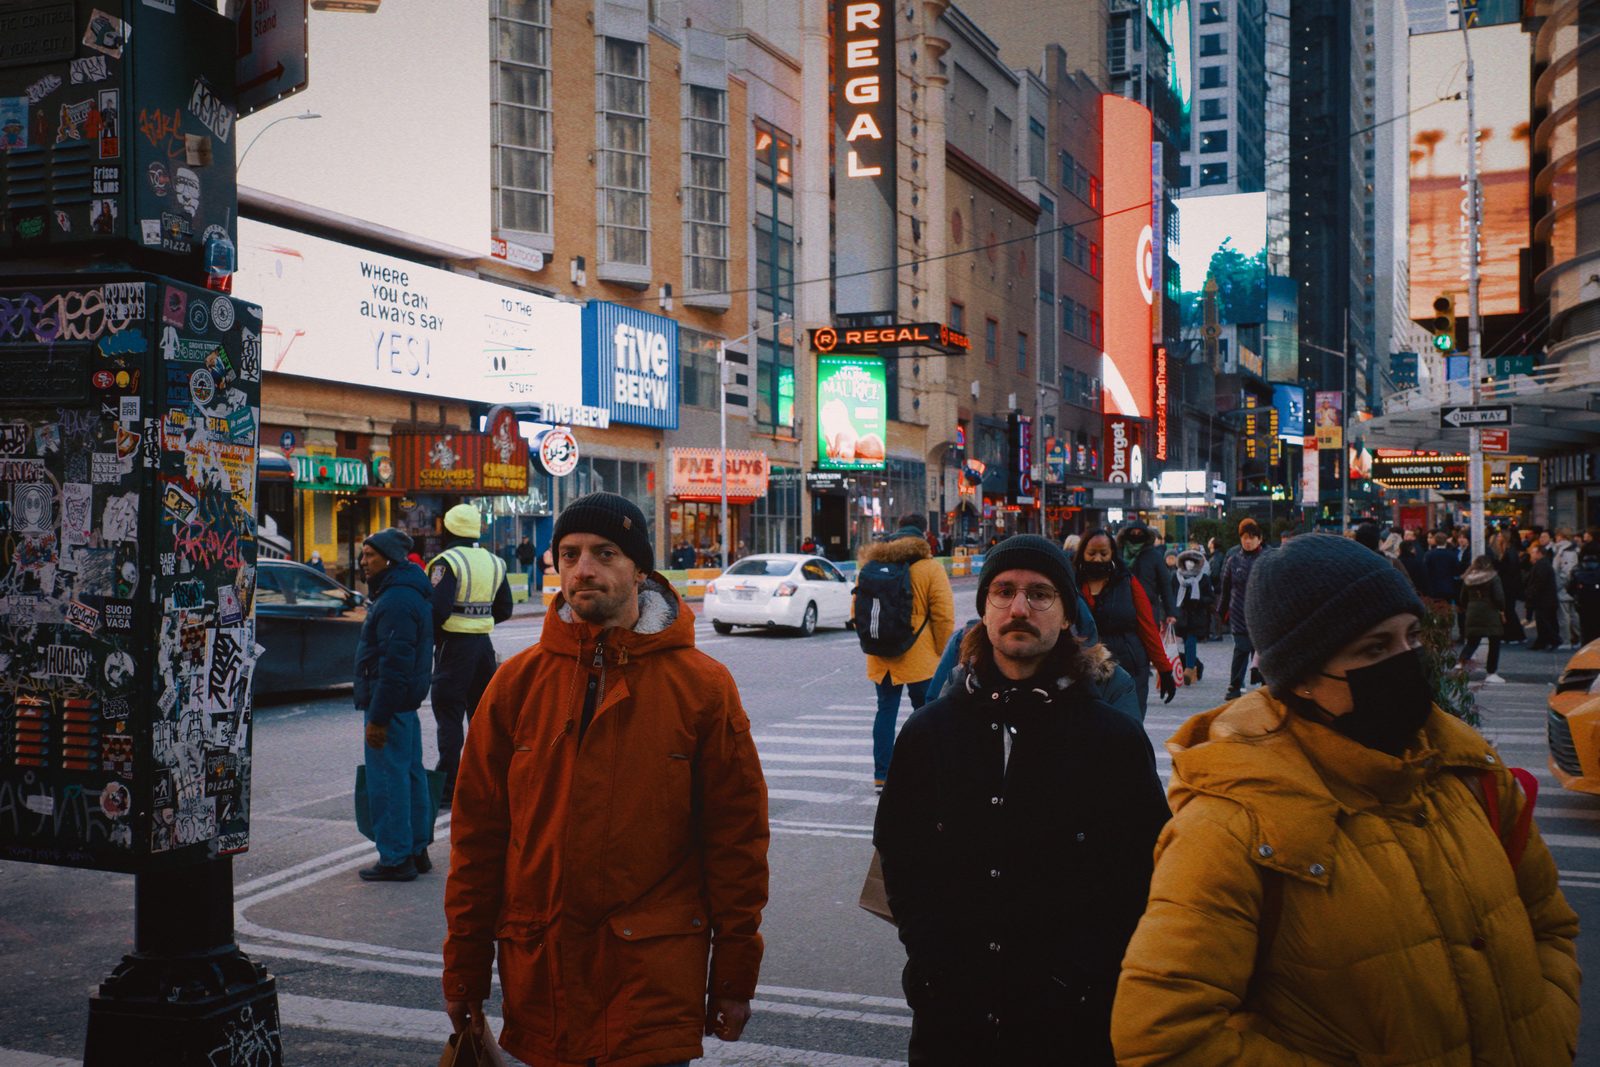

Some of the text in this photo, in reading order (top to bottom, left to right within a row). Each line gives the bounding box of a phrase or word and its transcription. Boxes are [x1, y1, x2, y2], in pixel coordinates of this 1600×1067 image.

[255, 15, 277, 36] Stand
[845, 2, 882, 178] REGAL
[163, 238, 192, 253] PIZZA
[104, 284, 143, 304] RUMOR
[846, 328, 929, 344] REGAL
[614, 323, 669, 378] five
[1503, 359, 1511, 373] 8
[614, 372, 669, 411] BELOW
[572, 406, 609, 428] BELOW
[1453, 411, 1502, 422] ONE WAY
[1111, 421, 1129, 471] target
[334, 461, 369, 486] PASTA
[678, 457, 763, 475] FIVE GUYS
[1391, 466, 1431, 475] WELCOME
[1432, 466, 1444, 474] TO
[420, 468, 475, 480] CRUMBS
[161, 563, 176, 576] ONE
[104, 604, 133, 616] SUCIO
[463, 606, 492, 615] NYP
[105, 618, 131, 630] VASA
[206, 778, 235, 792] PIZZA
